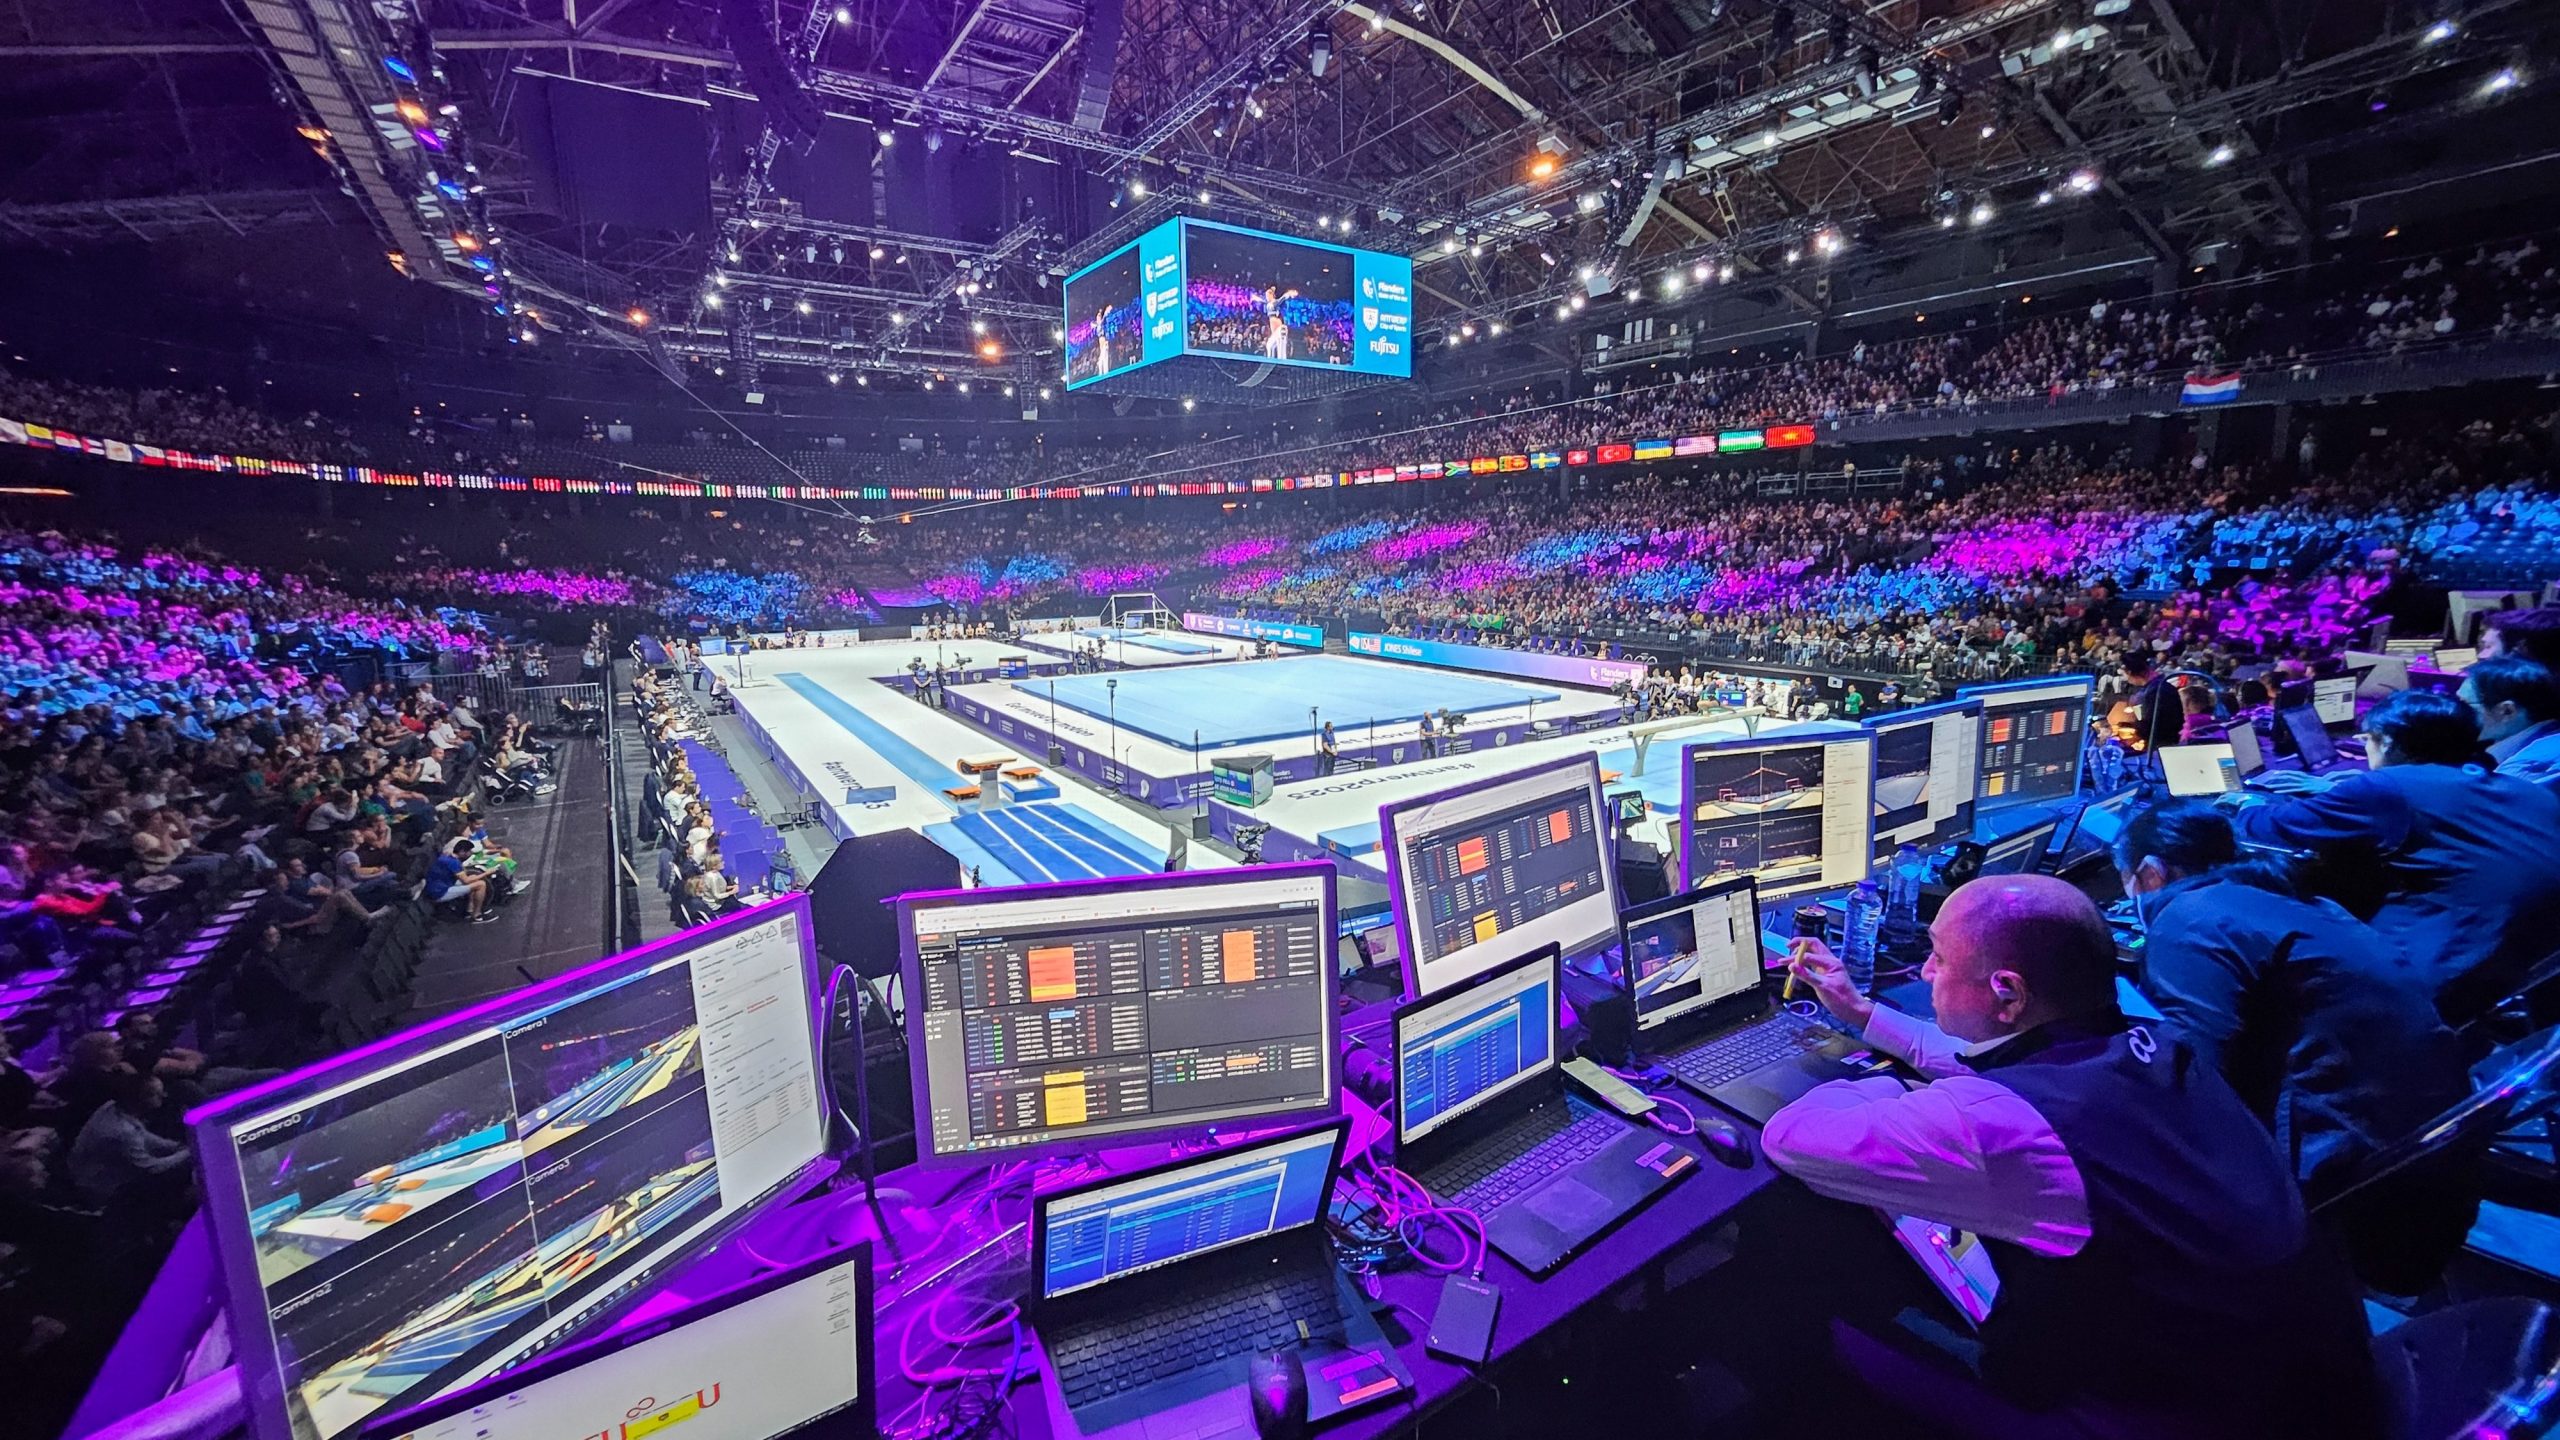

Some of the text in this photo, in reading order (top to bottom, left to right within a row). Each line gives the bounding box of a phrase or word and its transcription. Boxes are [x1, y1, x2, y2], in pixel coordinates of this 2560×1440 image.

[1378, 282, 1405, 295] Flanders
[1370, 336, 1400, 356] FUJITSU
[1601, 667, 1629, 678] Flanders
[1287, 763, 1476, 800] #antwerp2023
[505, 1016, 548, 1040] Camera1
[238, 1113, 302, 1145] Camera0
[528, 1158, 571, 1186] Camera3
[272, 1283, 333, 1320] Camera2
